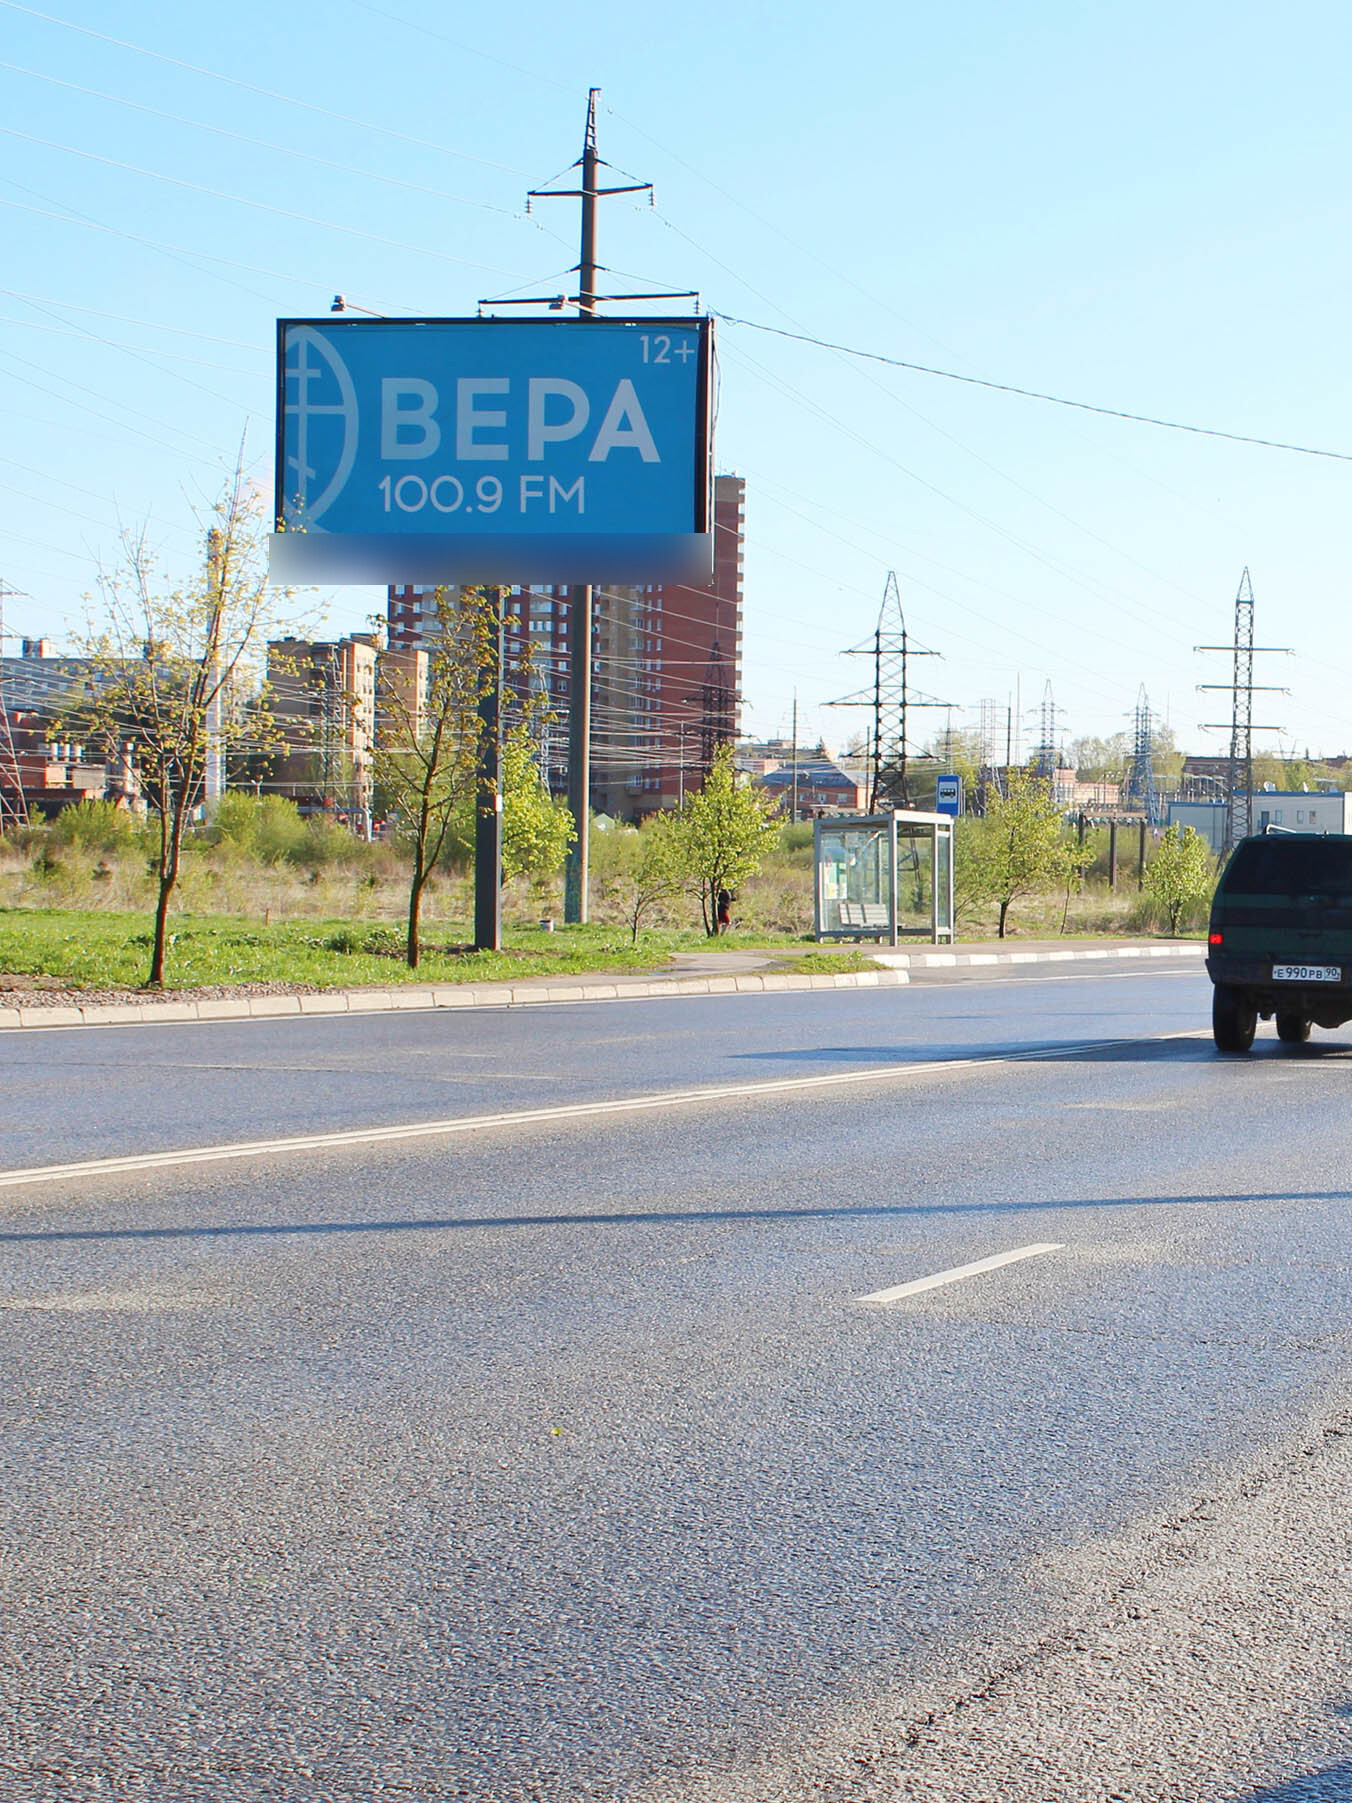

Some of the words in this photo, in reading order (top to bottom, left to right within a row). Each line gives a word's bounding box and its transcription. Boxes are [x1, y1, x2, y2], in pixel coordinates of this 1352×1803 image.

[639, 335, 695, 364] 12+
[379, 377, 661, 463] ВЕРА
[378, 475, 503, 513] 100.9
[520, 476, 585, 514] FM
